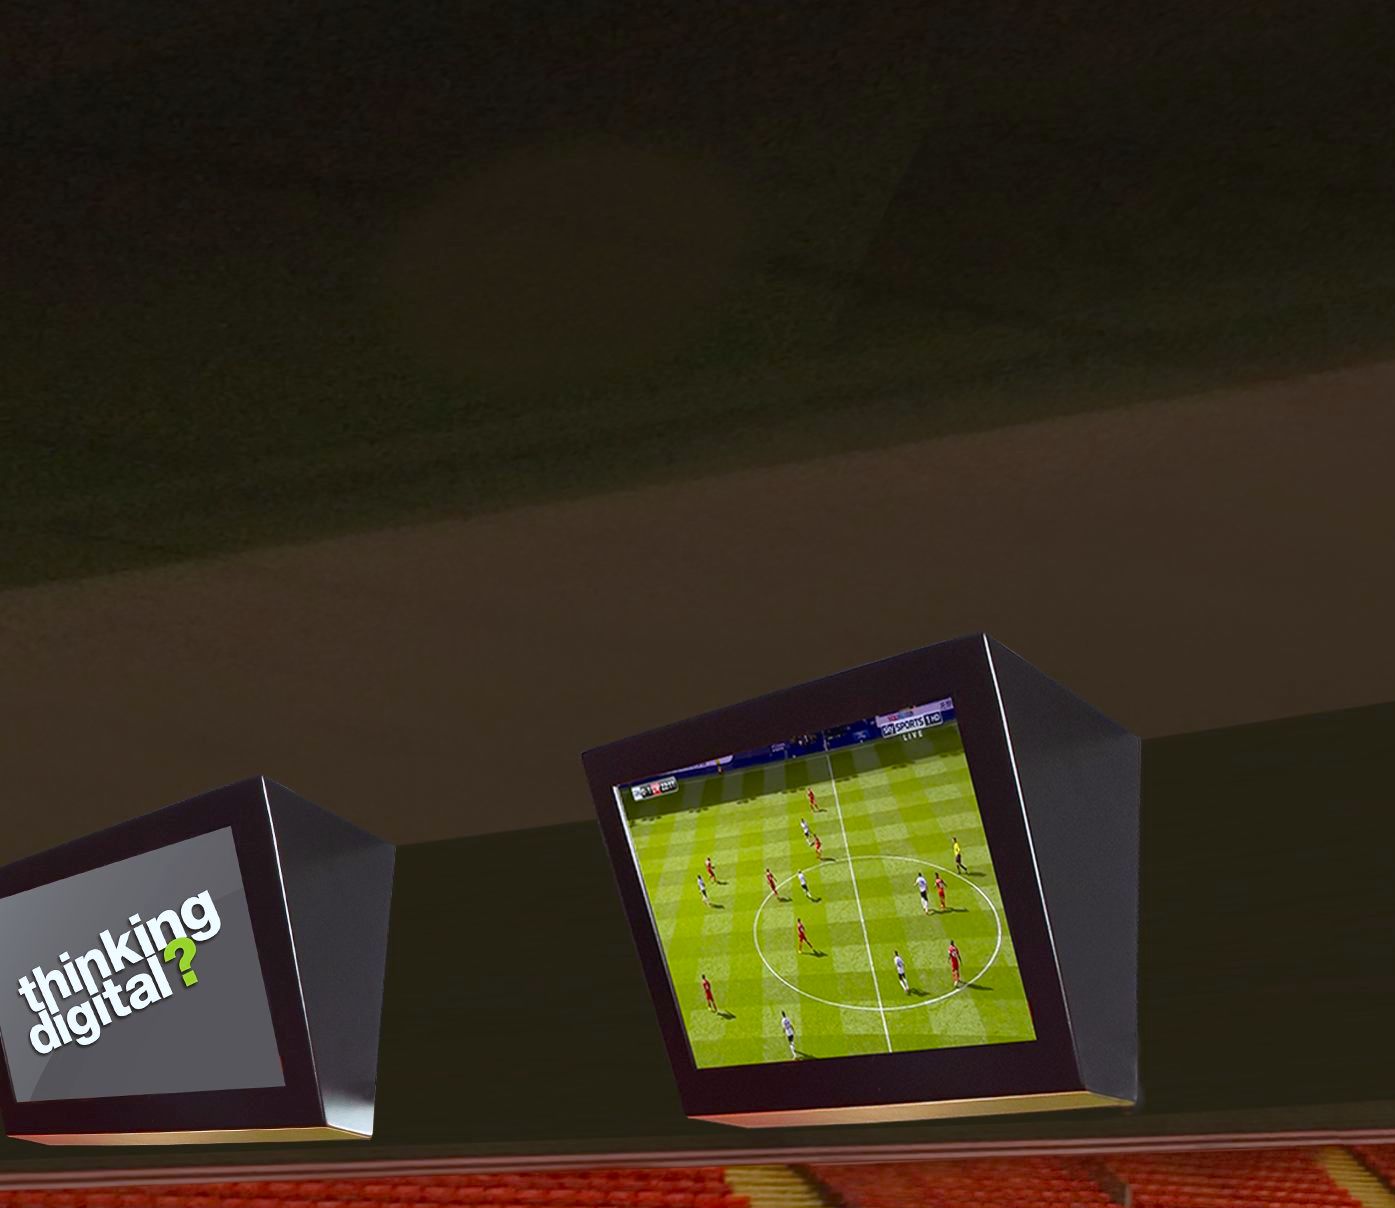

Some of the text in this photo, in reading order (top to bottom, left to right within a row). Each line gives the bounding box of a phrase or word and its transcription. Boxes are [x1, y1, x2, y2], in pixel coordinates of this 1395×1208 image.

[895, 716, 925, 734] SPORTS
[902, 730, 923, 741] LIVE
[18, 889, 222, 1016] thinking
